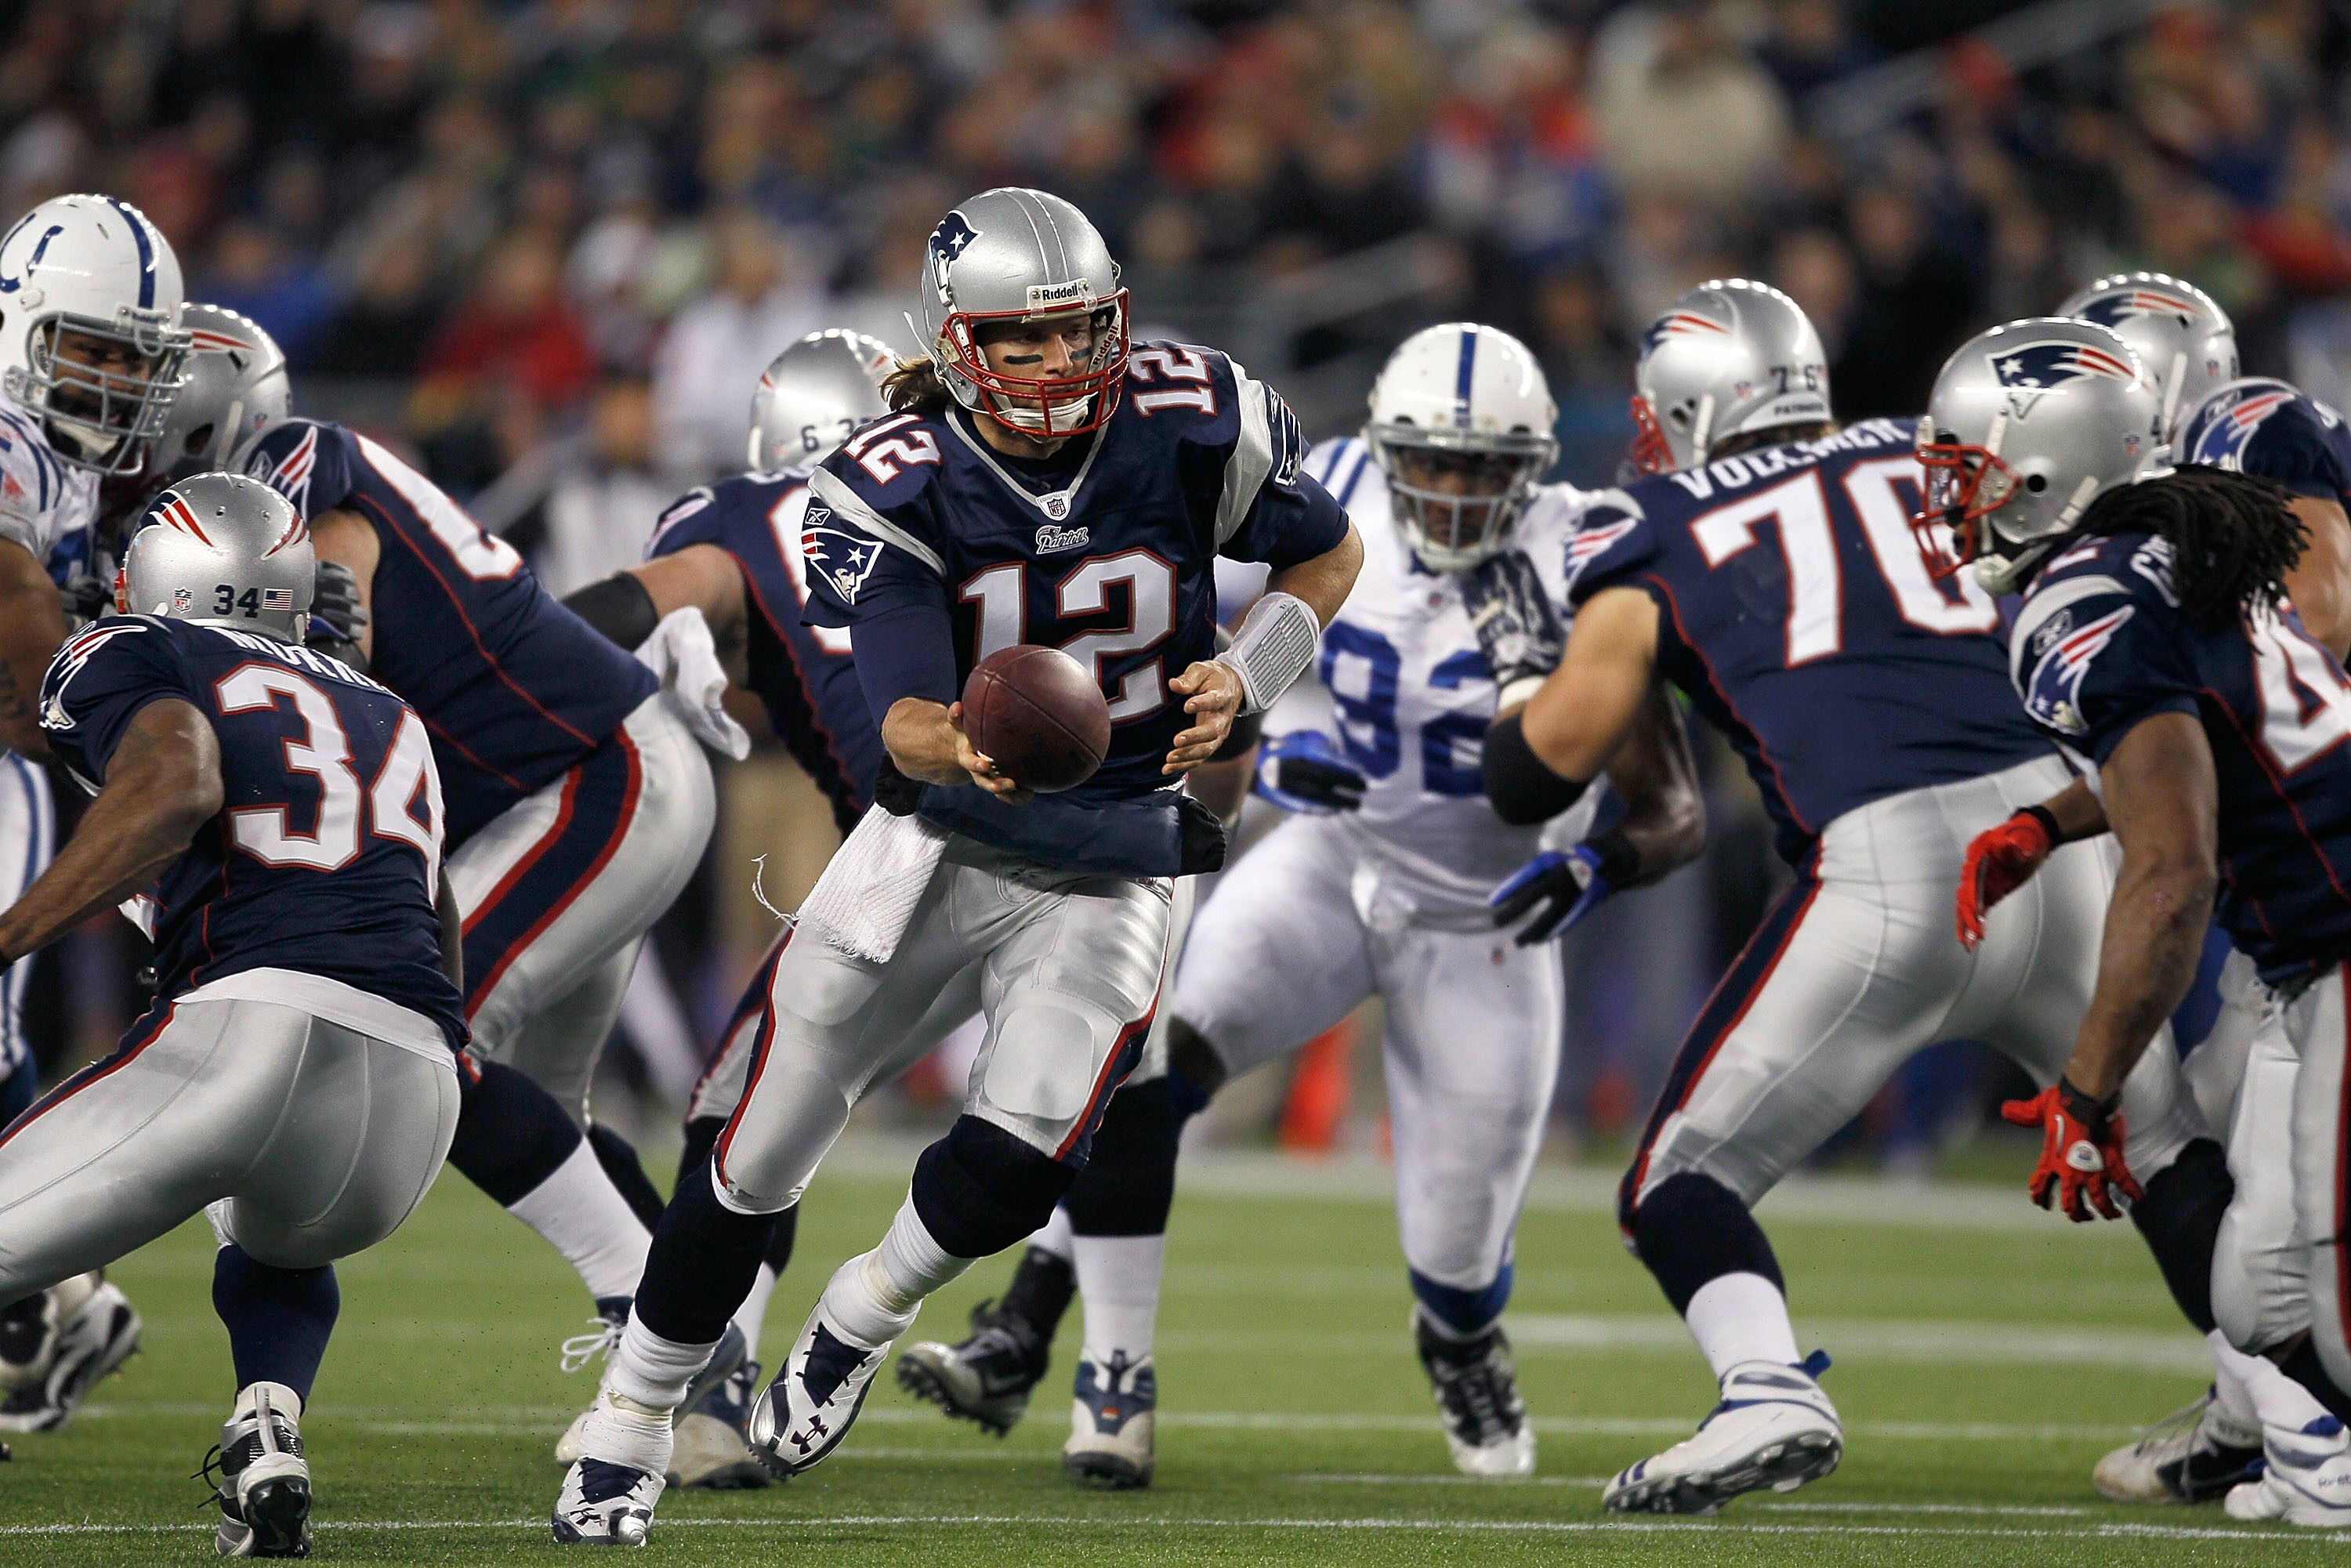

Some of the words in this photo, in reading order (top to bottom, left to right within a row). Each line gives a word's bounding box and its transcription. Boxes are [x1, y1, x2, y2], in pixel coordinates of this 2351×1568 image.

[1041, 282, 1078, 301] Riddell
[1128, 348, 1218, 418] 12
[842, 414, 944, 487] 12
[1036, 525, 1089, 554] Patriots
[213, 584, 259, 618] 34
[958, 546, 1177, 725] 12
[1319, 621, 1495, 798] 92
[213, 660, 446, 907] 34
